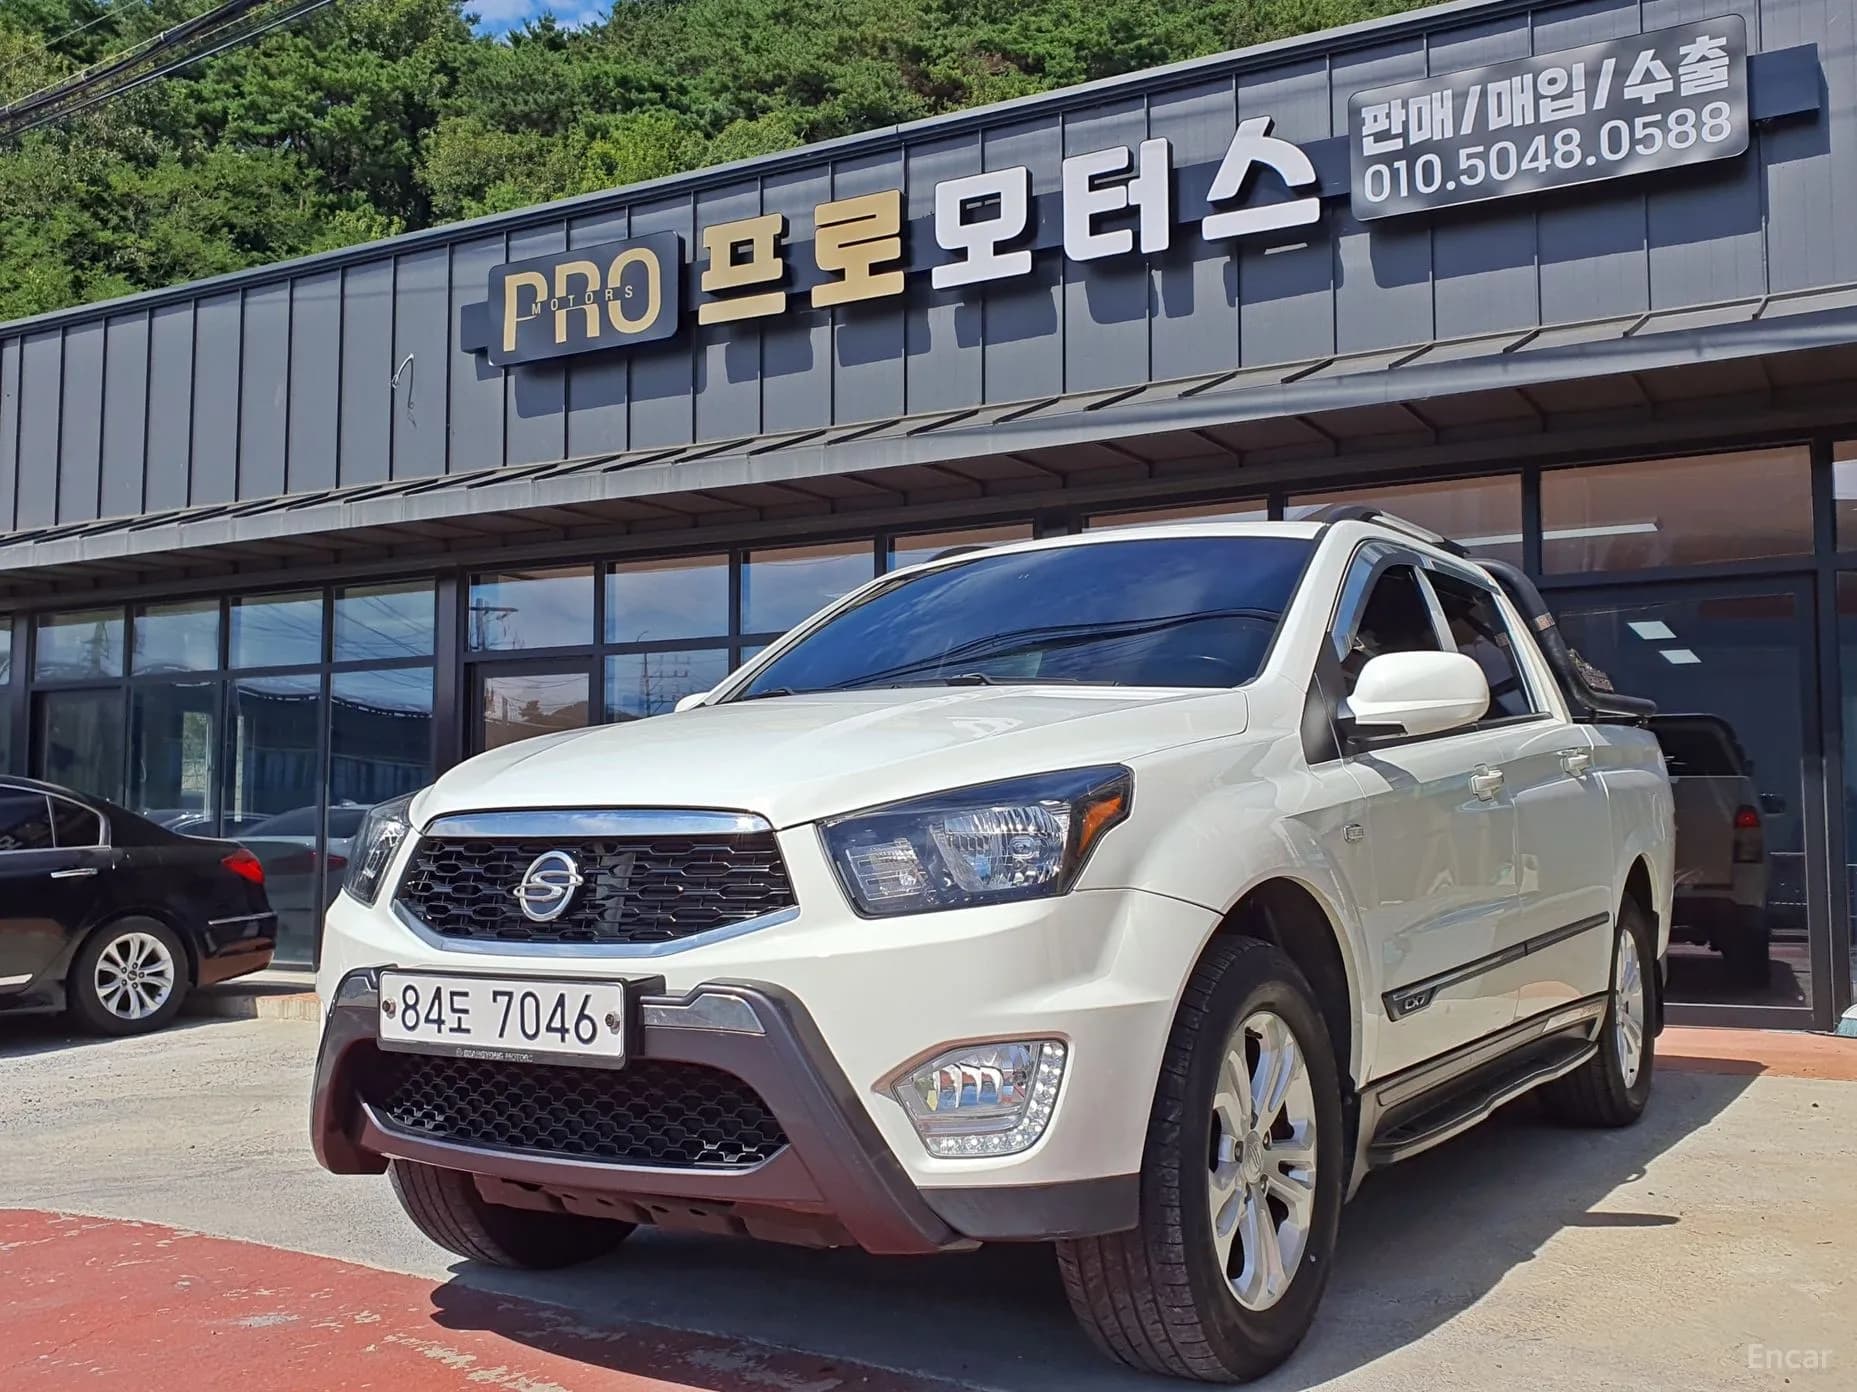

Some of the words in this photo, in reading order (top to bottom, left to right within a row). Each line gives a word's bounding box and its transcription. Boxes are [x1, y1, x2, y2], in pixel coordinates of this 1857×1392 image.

[1361, 35, 1729, 156] 판매/매입/수출
[1364, 101, 1731, 202] 010.5048.0588
[698, 115, 1320, 325] 프로모터스
[503, 247, 662, 351] PRO
[531, 285, 633, 315] MOTORS
[401, 984, 472, 1034] 84도
[491, 989, 599, 1045] 7046
